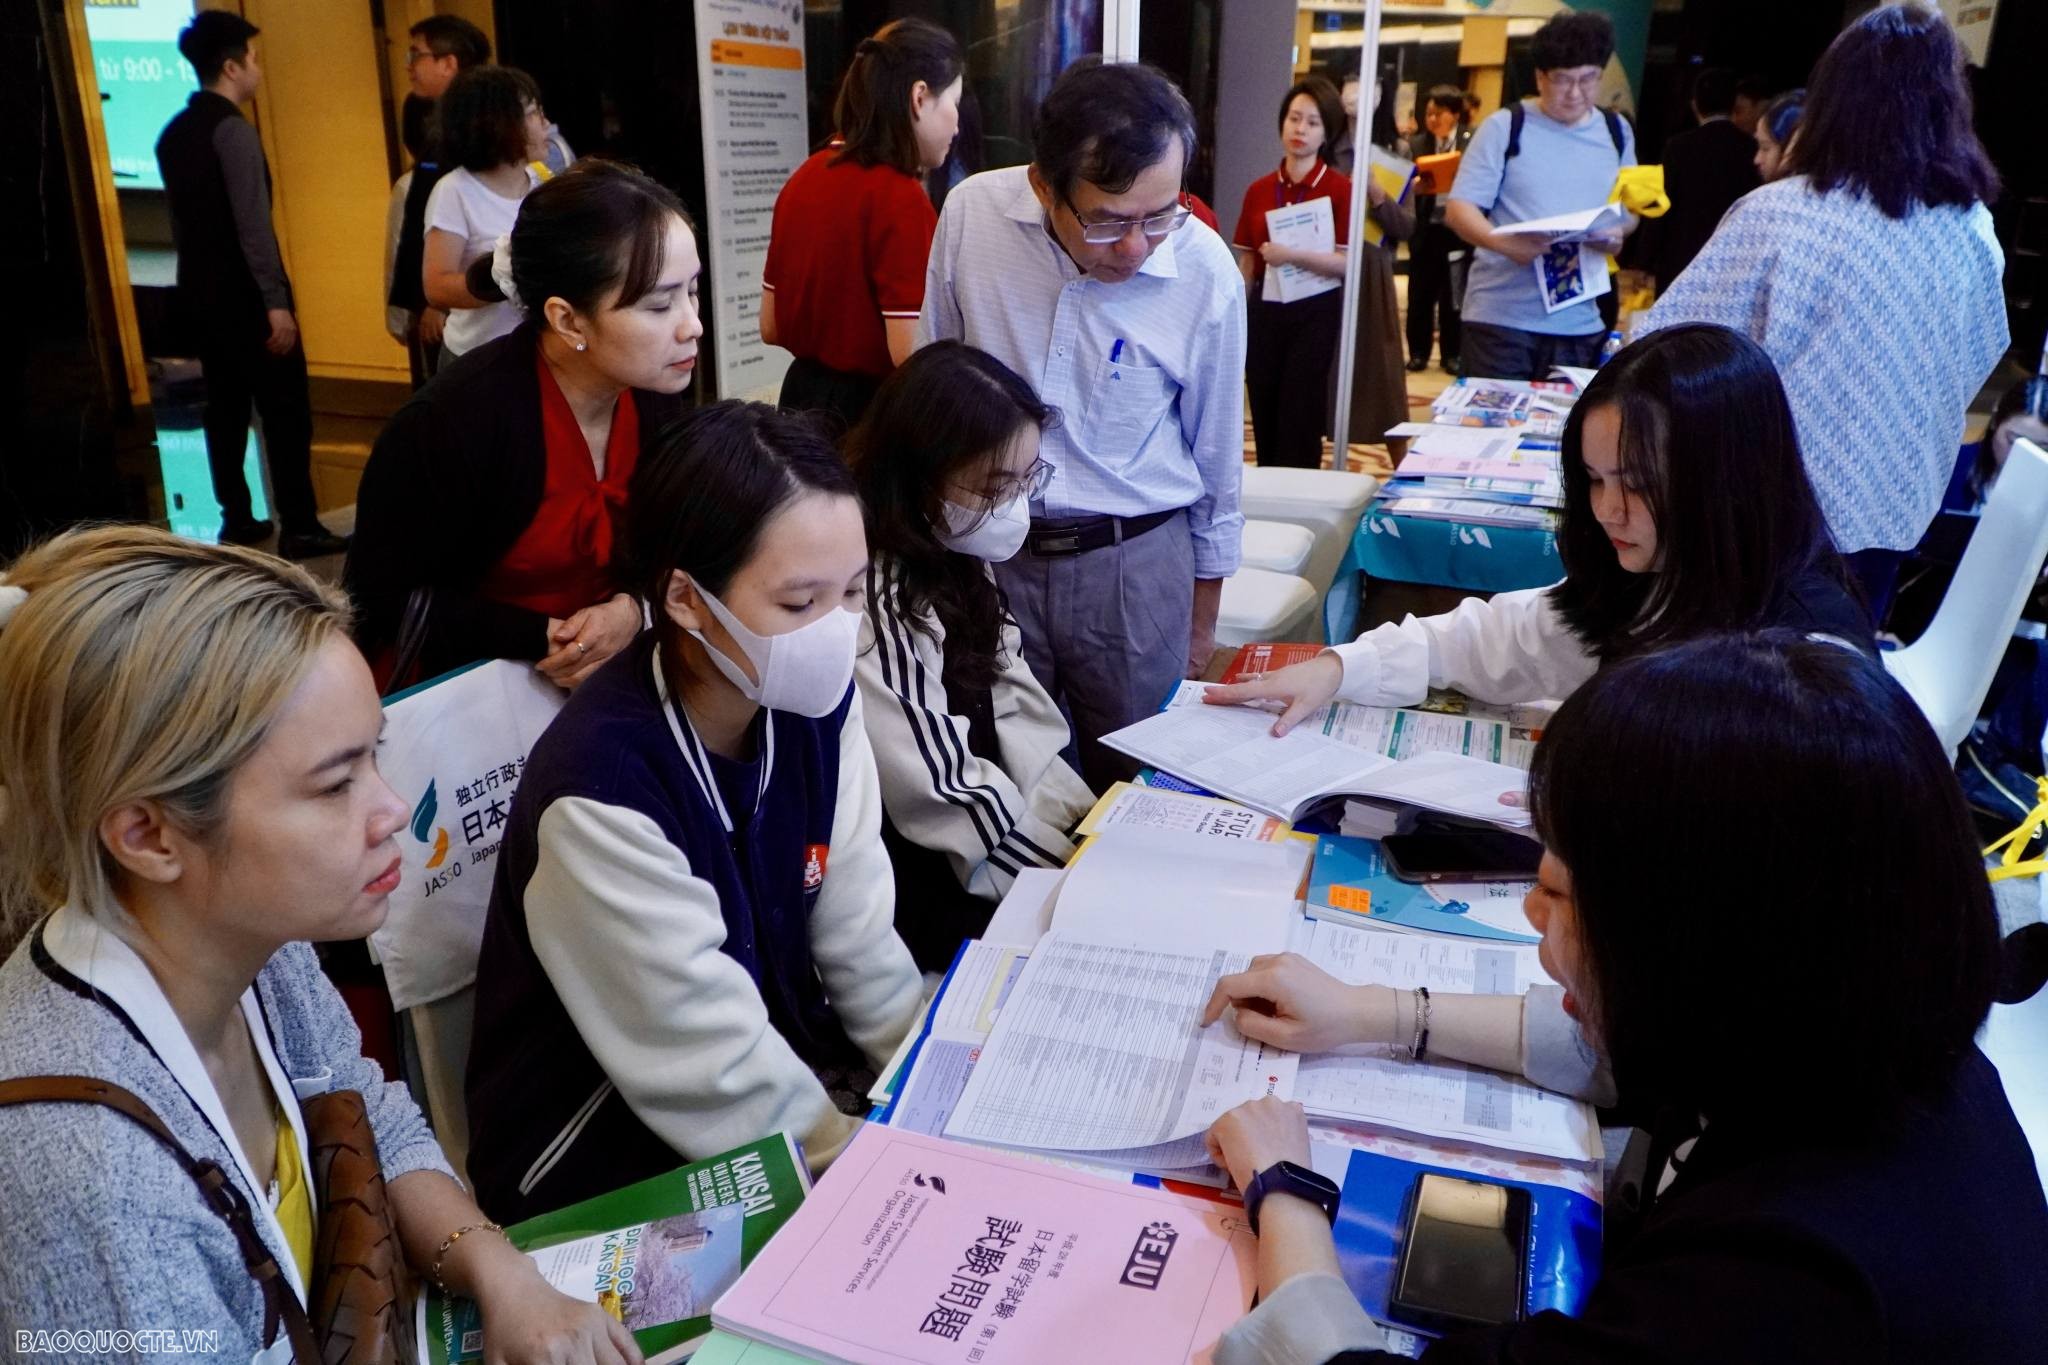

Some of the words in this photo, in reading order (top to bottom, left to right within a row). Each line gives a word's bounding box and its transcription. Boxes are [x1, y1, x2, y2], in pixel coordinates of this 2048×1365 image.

[123, 57, 162, 82] 9:00
[425, 862, 462, 897] JASSO
[697, 1168, 714, 1191] GUIDE
[730, 1151, 775, 1218] KANSAI
[900, 1168, 915, 1186] JASSO
[862, 1190, 906, 1246] Organization
[898, 1194, 919, 1220] Japan
[621, 1227, 642, 1251] ĐẠI
[871, 1220, 902, 1256] Student
[594, 1233, 620, 1292] KANSAI
[614, 1255, 637, 1294] HỌC
[845, 1257, 878, 1294] Services
[919, 1216, 1023, 1342] 試験問題
[991, 1229, 1054, 1320] 日本留学試験
[1127, 1238, 1170, 1286] EJU
